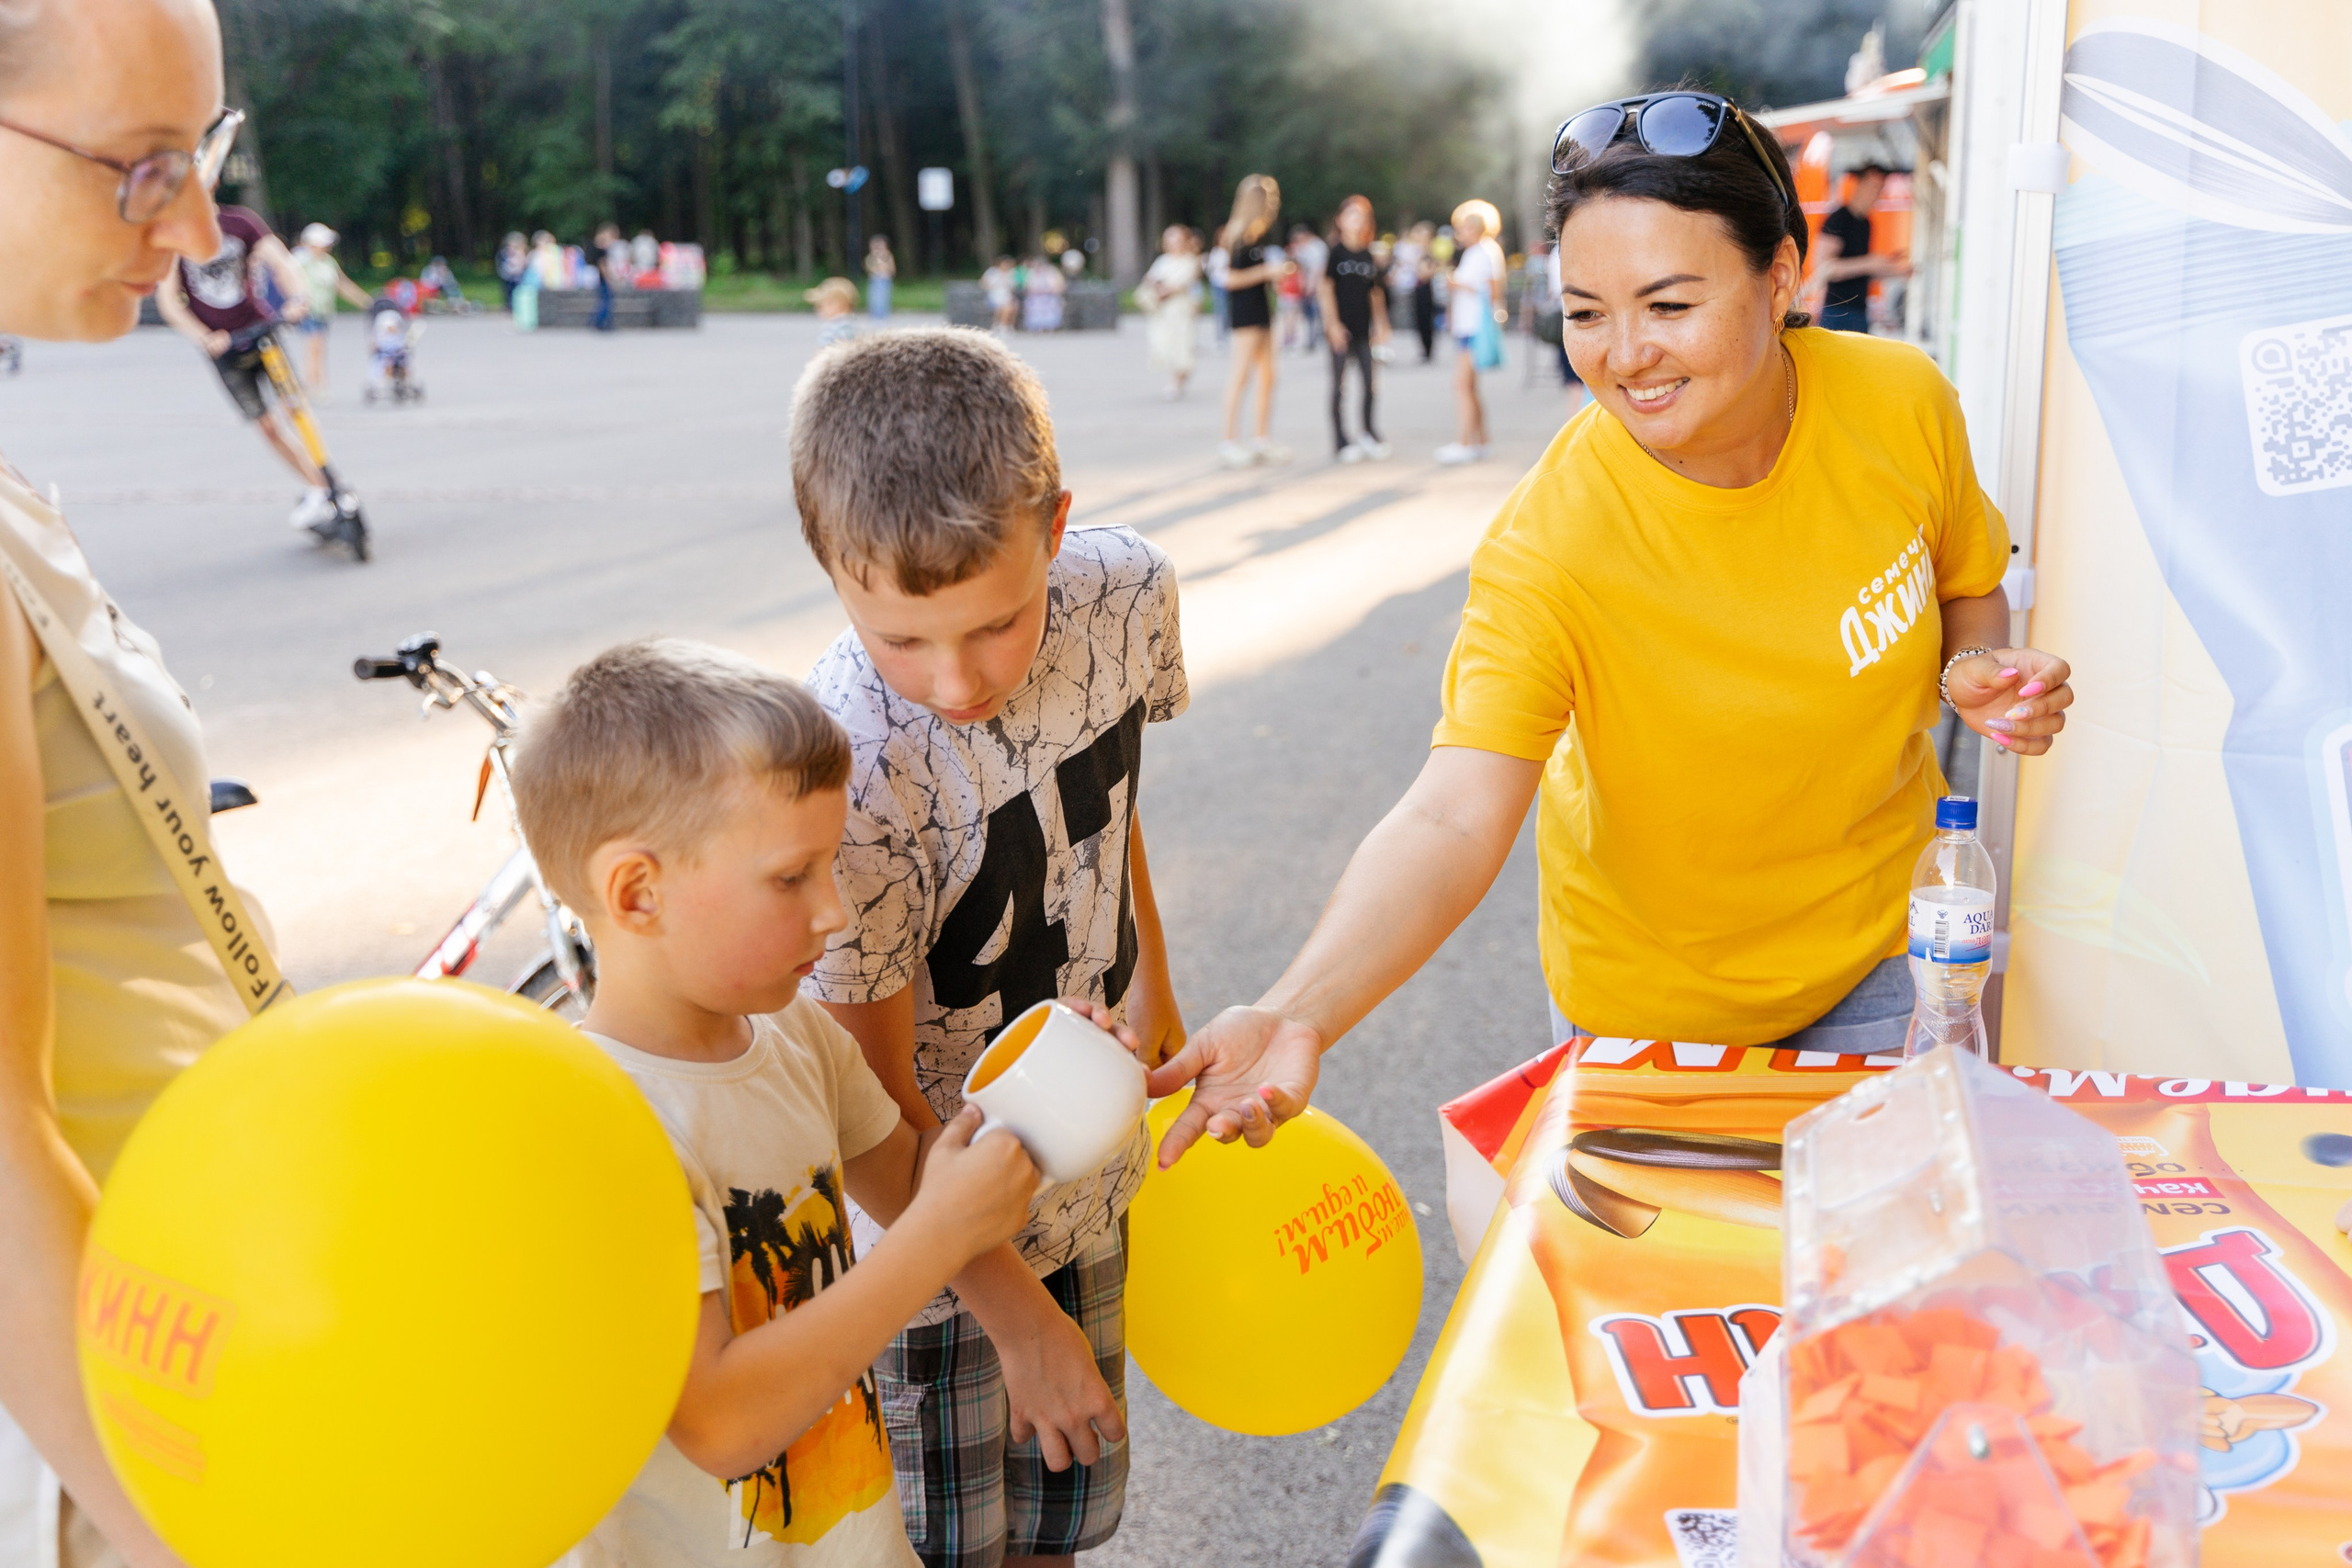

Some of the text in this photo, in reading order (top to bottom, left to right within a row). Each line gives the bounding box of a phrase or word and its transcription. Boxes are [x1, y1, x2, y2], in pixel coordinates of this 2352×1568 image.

[93, 690, 270, 999] Follow your heart
[1274, 1174, 1369, 1258] и едим!
